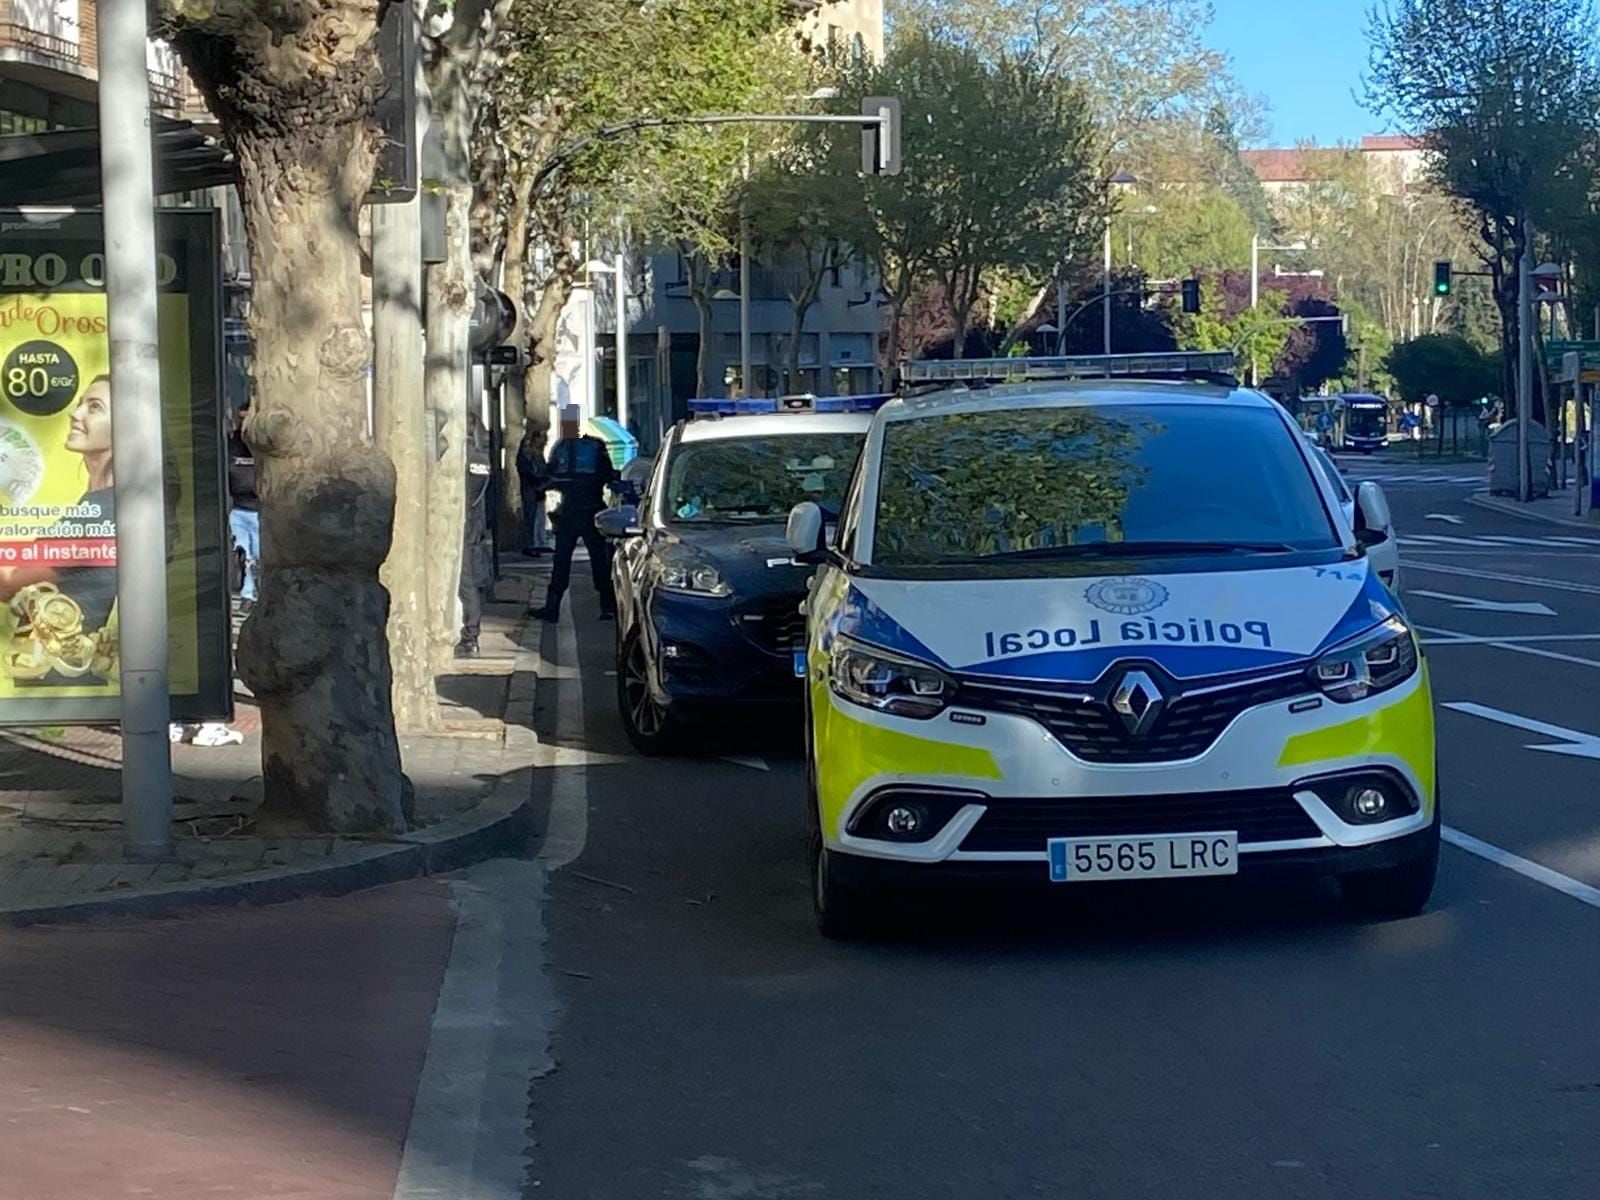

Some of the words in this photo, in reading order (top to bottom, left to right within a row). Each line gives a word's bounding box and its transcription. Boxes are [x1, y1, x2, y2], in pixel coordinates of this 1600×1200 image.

[0, 253, 66, 286] RO
[35, 307, 106, 335] Oros
[19, 353, 60, 364] HASTA
[8, 367, 48, 397] 80
[0, 505, 60, 518] busque
[65, 502, 99, 516] más
[22, 543, 38, 559] al
[43, 543, 116, 559] instante
[1075, 842, 1156, 873] 5565
[1169, 839, 1229, 869] LRC
